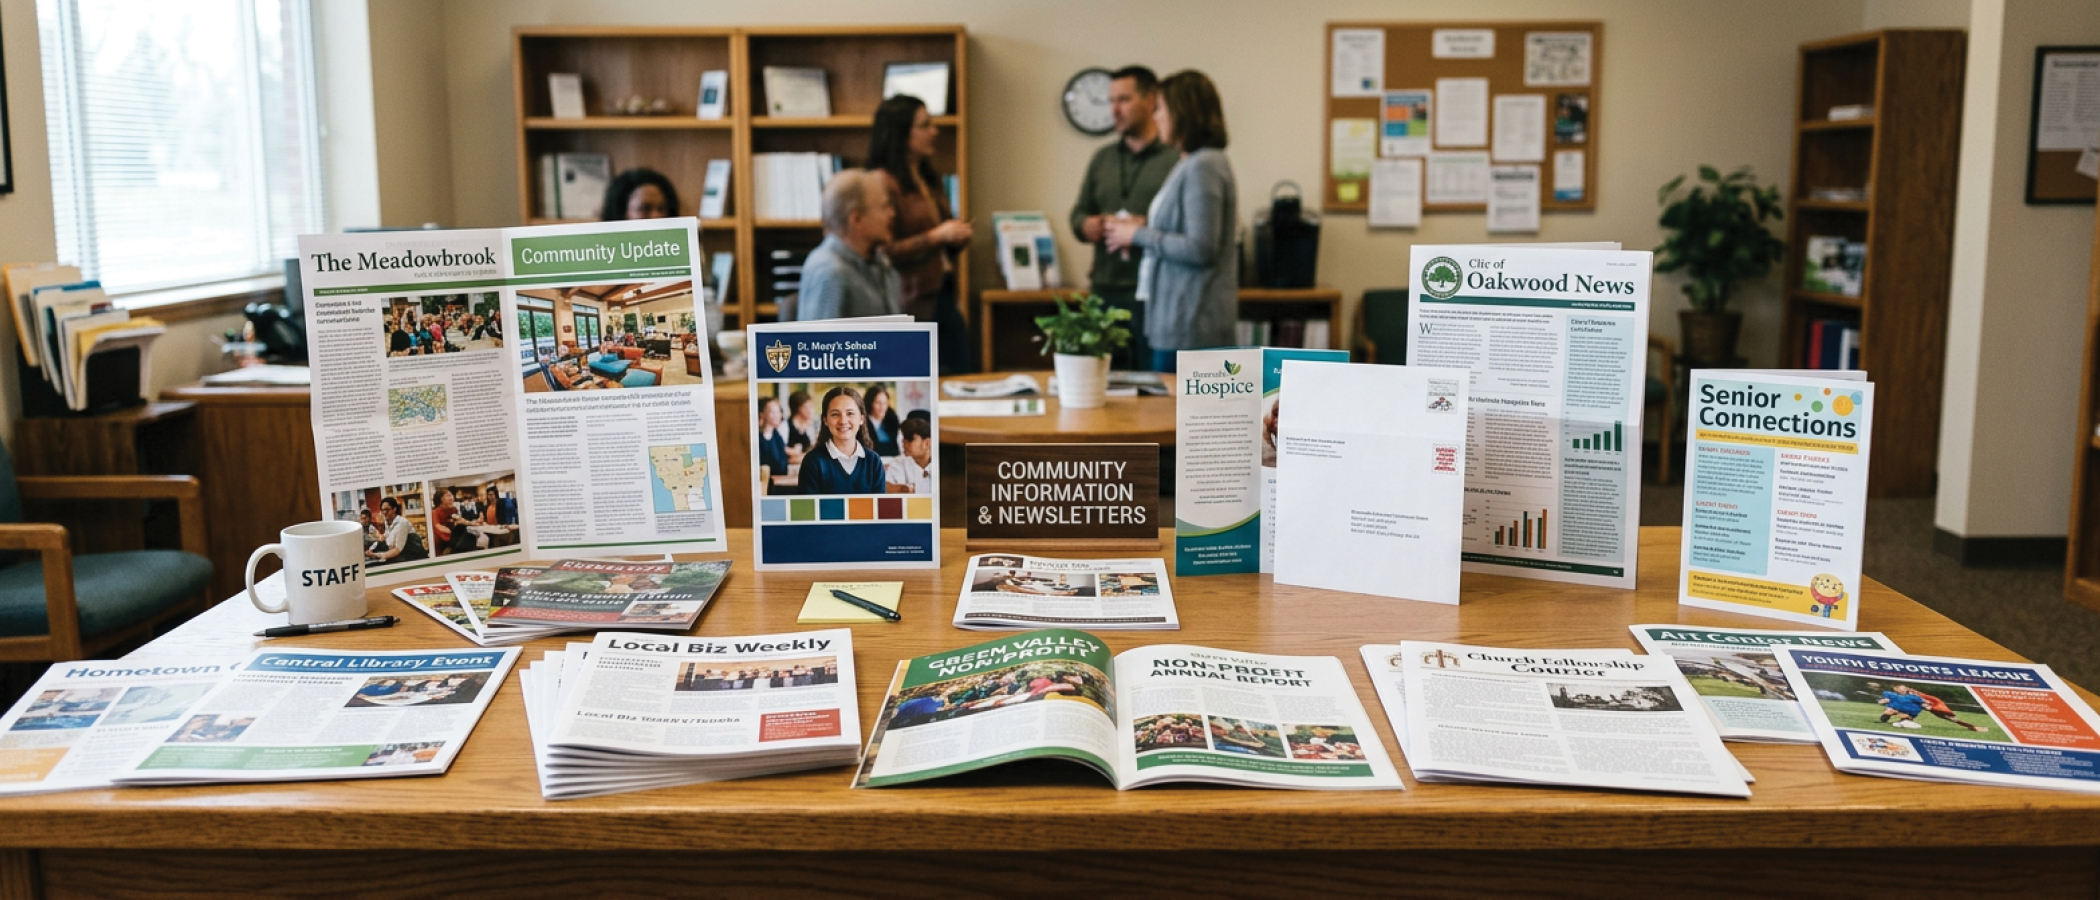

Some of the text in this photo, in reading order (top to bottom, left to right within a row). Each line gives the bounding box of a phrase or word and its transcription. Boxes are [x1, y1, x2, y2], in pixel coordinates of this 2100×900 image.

[311, 247, 496, 272] The Meadowbrook
[521, 240, 681, 265] Community Update
[1493, 258, 1506, 270] of
[1467, 271, 1635, 295] Oakwood News
[797, 352, 871, 371] Bulletin
[1185, 377, 1254, 399] Hospice
[1700, 383, 1782, 409] Senior
[1699, 406, 1857, 439] Connections
[998, 461, 1127, 480] COMMUNITY
[991, 482, 1134, 502] INFORMATION
[977, 505, 1147, 525] & NEWSLETTERS
[301, 563, 359, 587] STAFF
[608, 638, 832, 654] Local Biz Weekly
[1012, 636, 1100, 653] VALLEY
[65, 664, 221, 678] Hometown
[1150, 668, 1231, 681] ANNUAL
